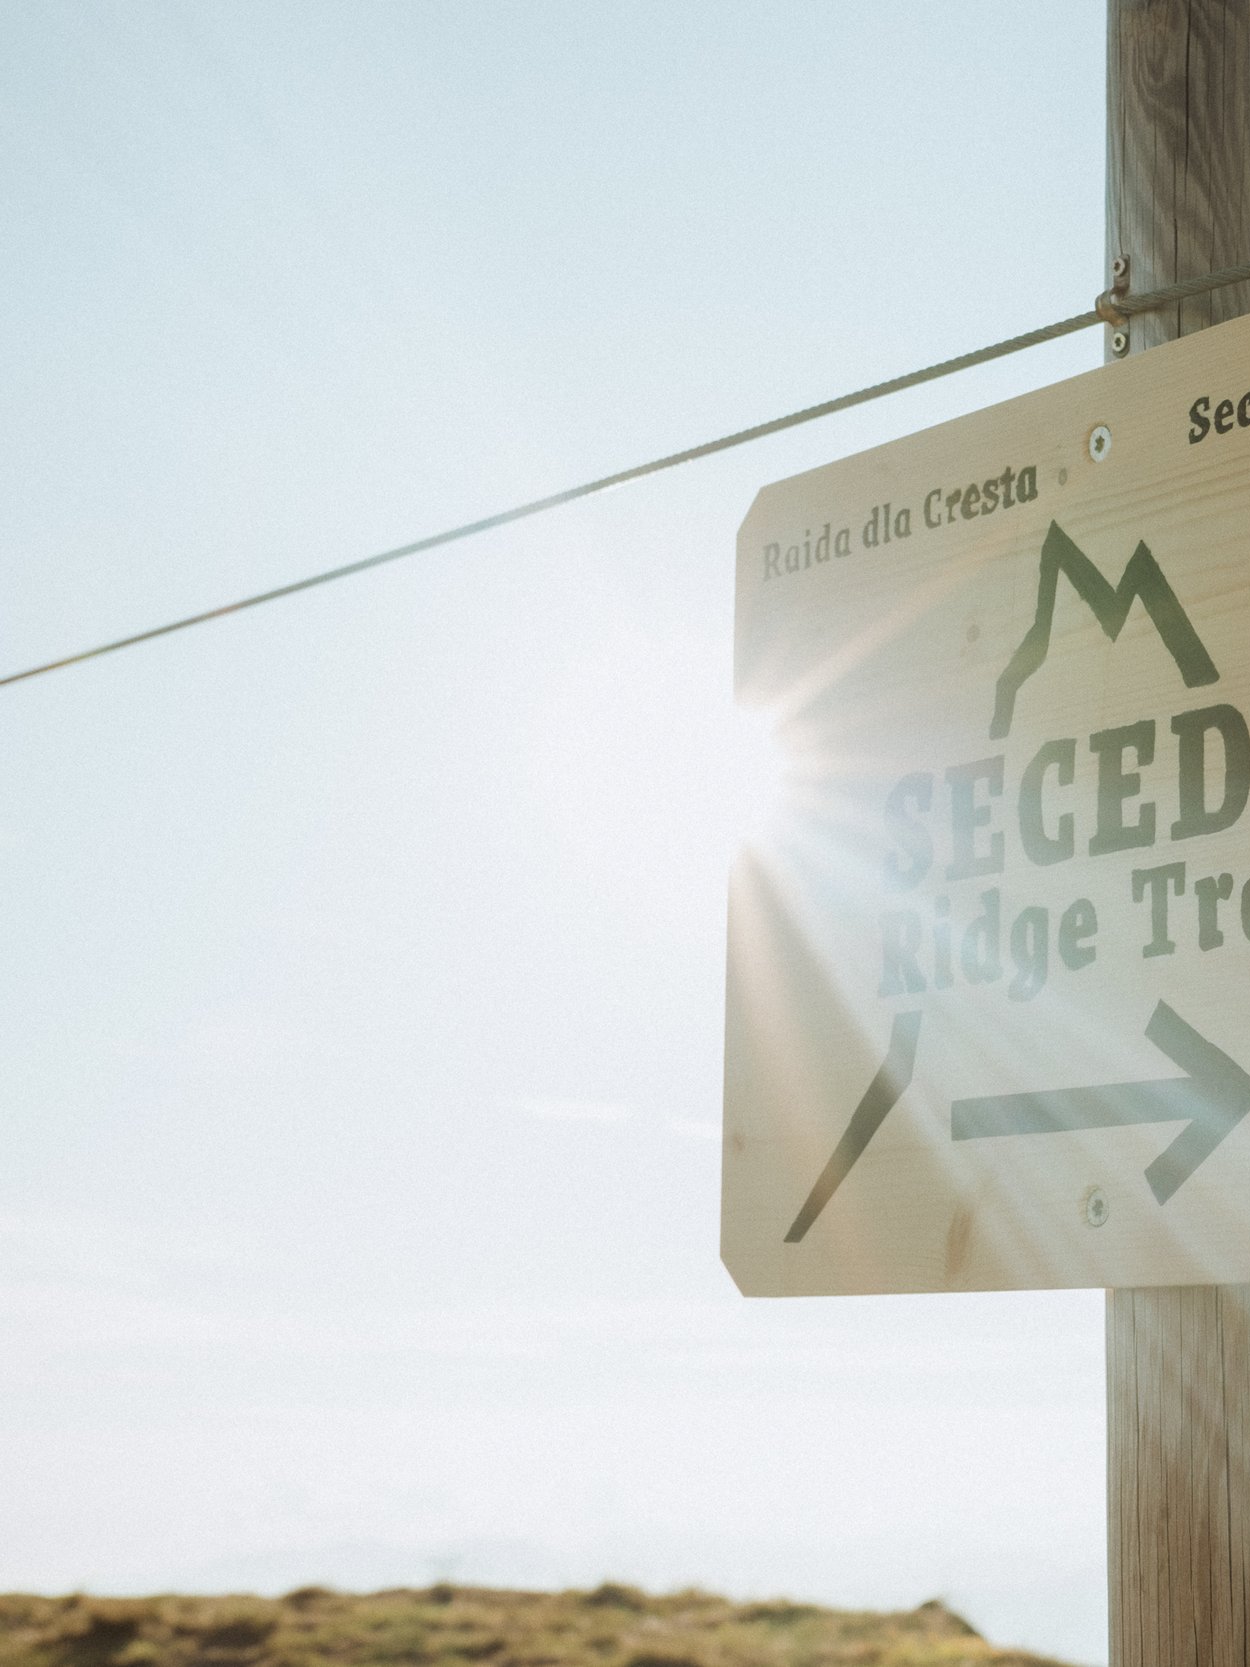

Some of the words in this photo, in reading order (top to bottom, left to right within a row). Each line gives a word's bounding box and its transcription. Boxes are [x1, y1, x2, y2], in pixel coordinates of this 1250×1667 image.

[762, 523, 852, 582] Raida
[862, 503, 912, 549] dla
[923, 465, 1038, 529] Cresta
[877, 886, 1097, 1001] Ridge
